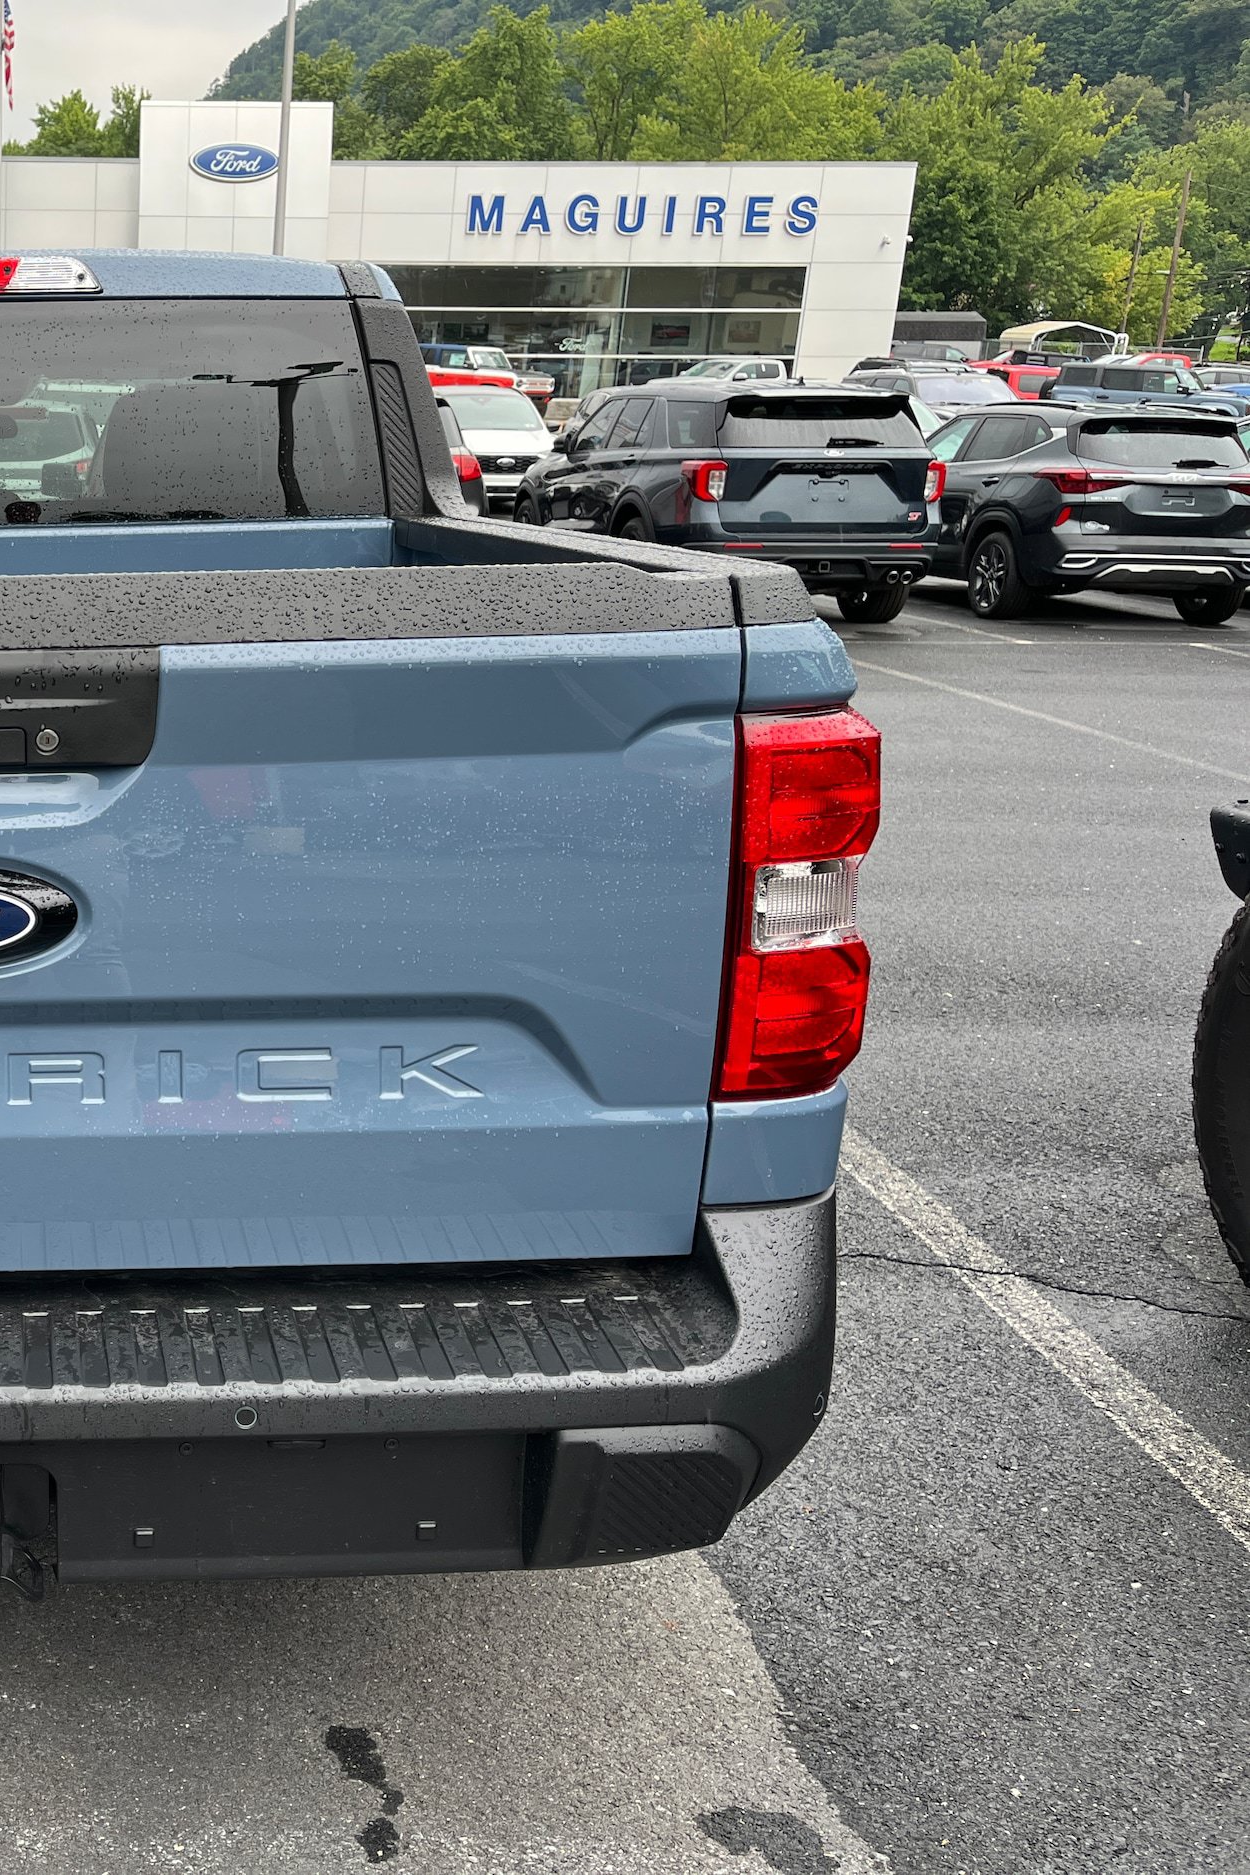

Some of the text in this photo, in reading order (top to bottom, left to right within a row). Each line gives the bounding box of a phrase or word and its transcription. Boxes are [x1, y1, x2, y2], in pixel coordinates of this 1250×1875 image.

[210, 148, 261, 174] Ford
[467, 193, 819, 236] MAGUIRES
[907, 511, 922, 522] ST
